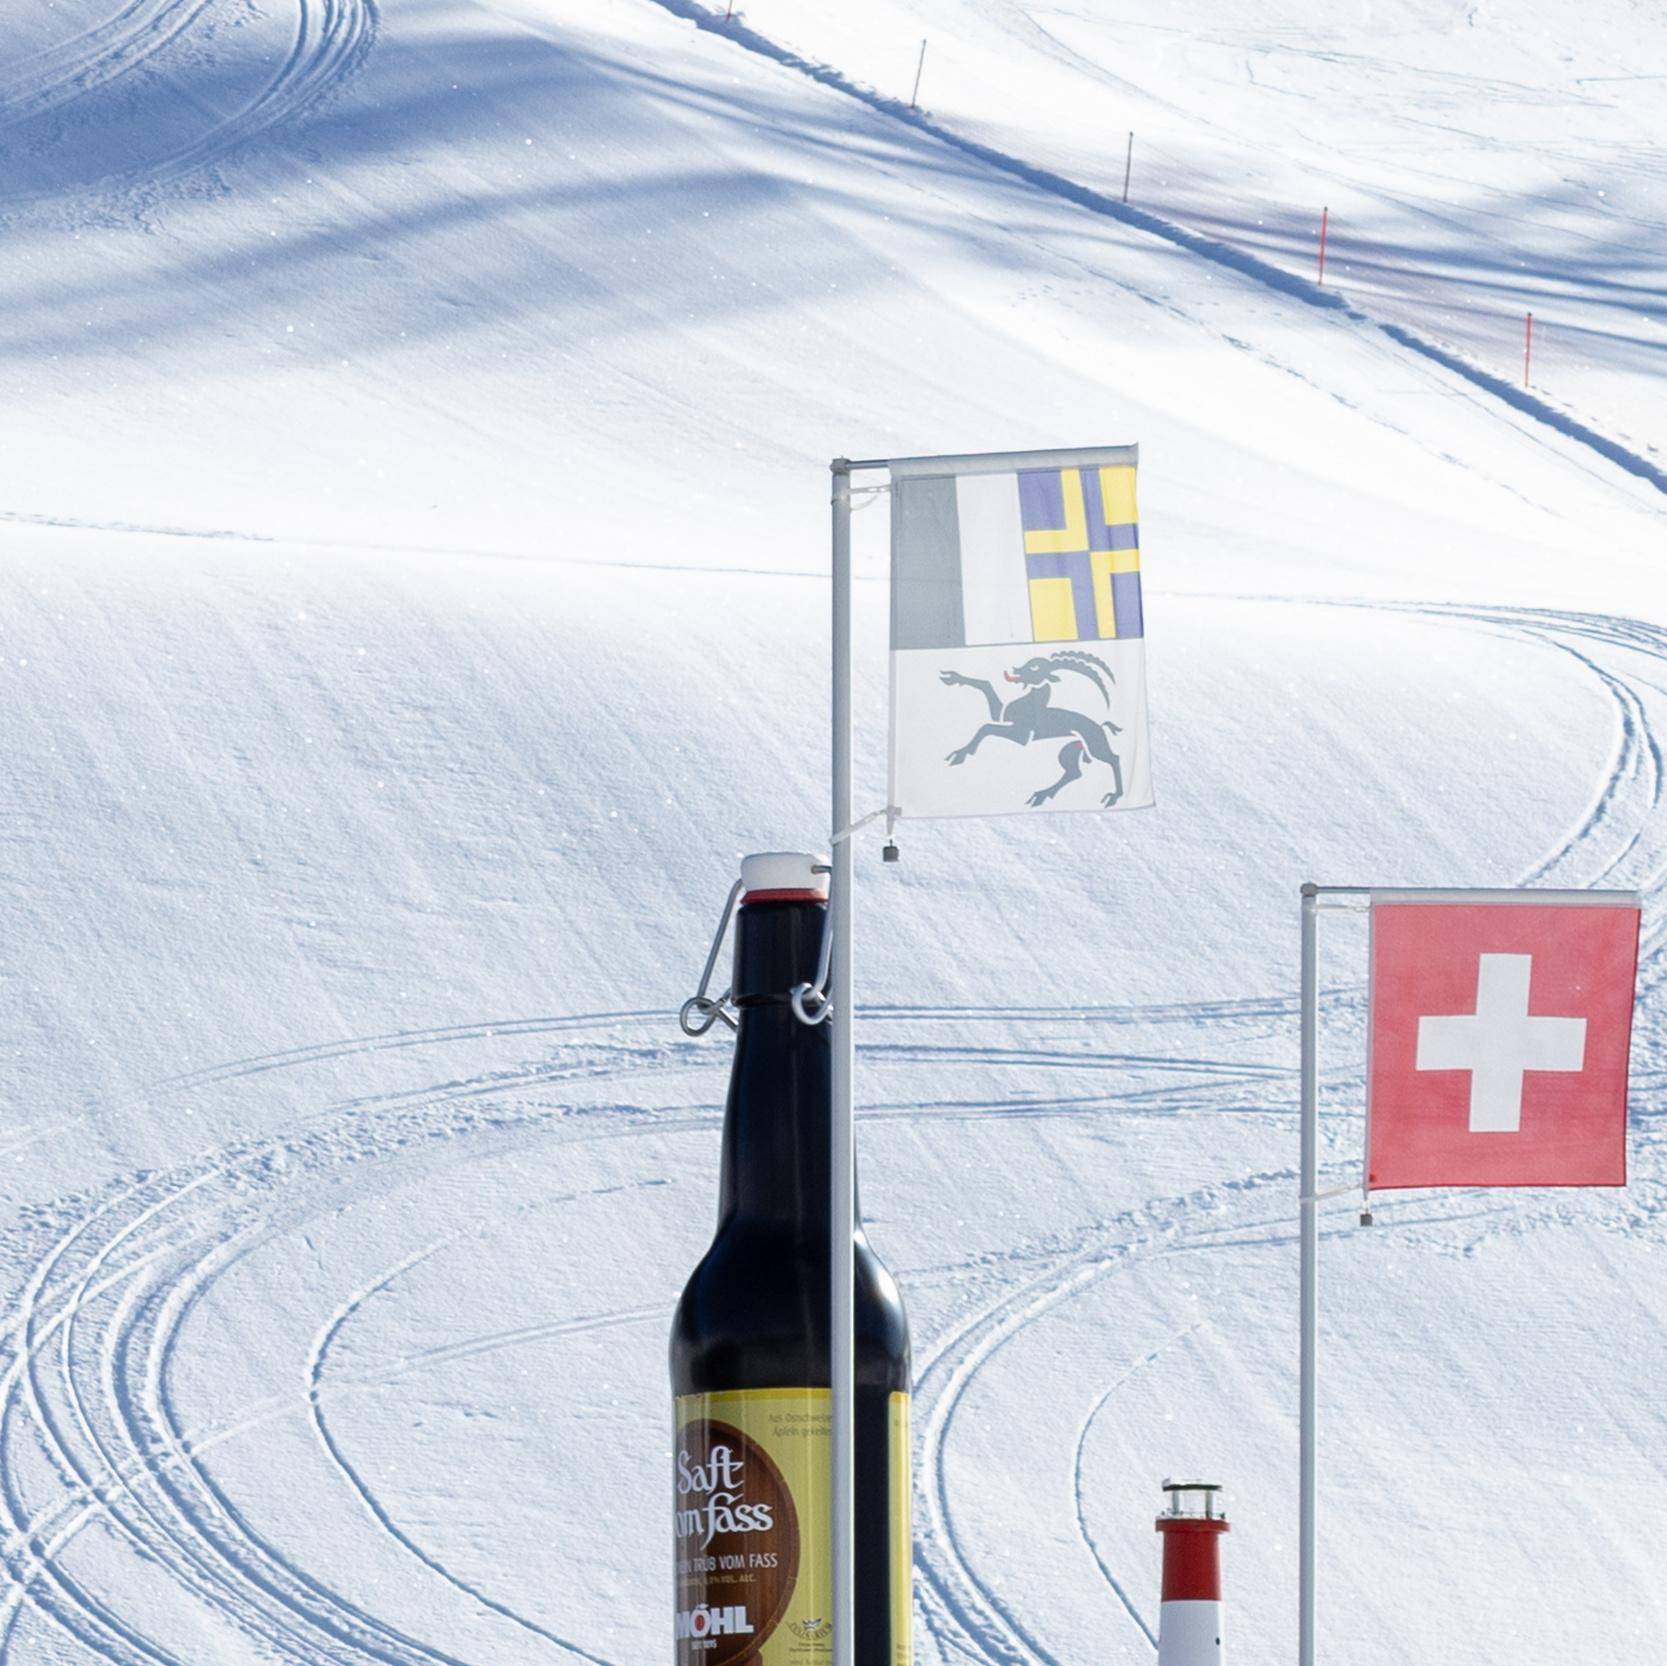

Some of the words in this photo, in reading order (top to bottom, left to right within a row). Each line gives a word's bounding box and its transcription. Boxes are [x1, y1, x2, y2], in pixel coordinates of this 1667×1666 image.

[677, 1445, 745, 1495] Saft
[674, 1508, 705, 1538] om
[719, 1554, 745, 1570] VOM
[750, 1553, 778, 1568] FASS
[674, 1603, 754, 1639] MÖHL
